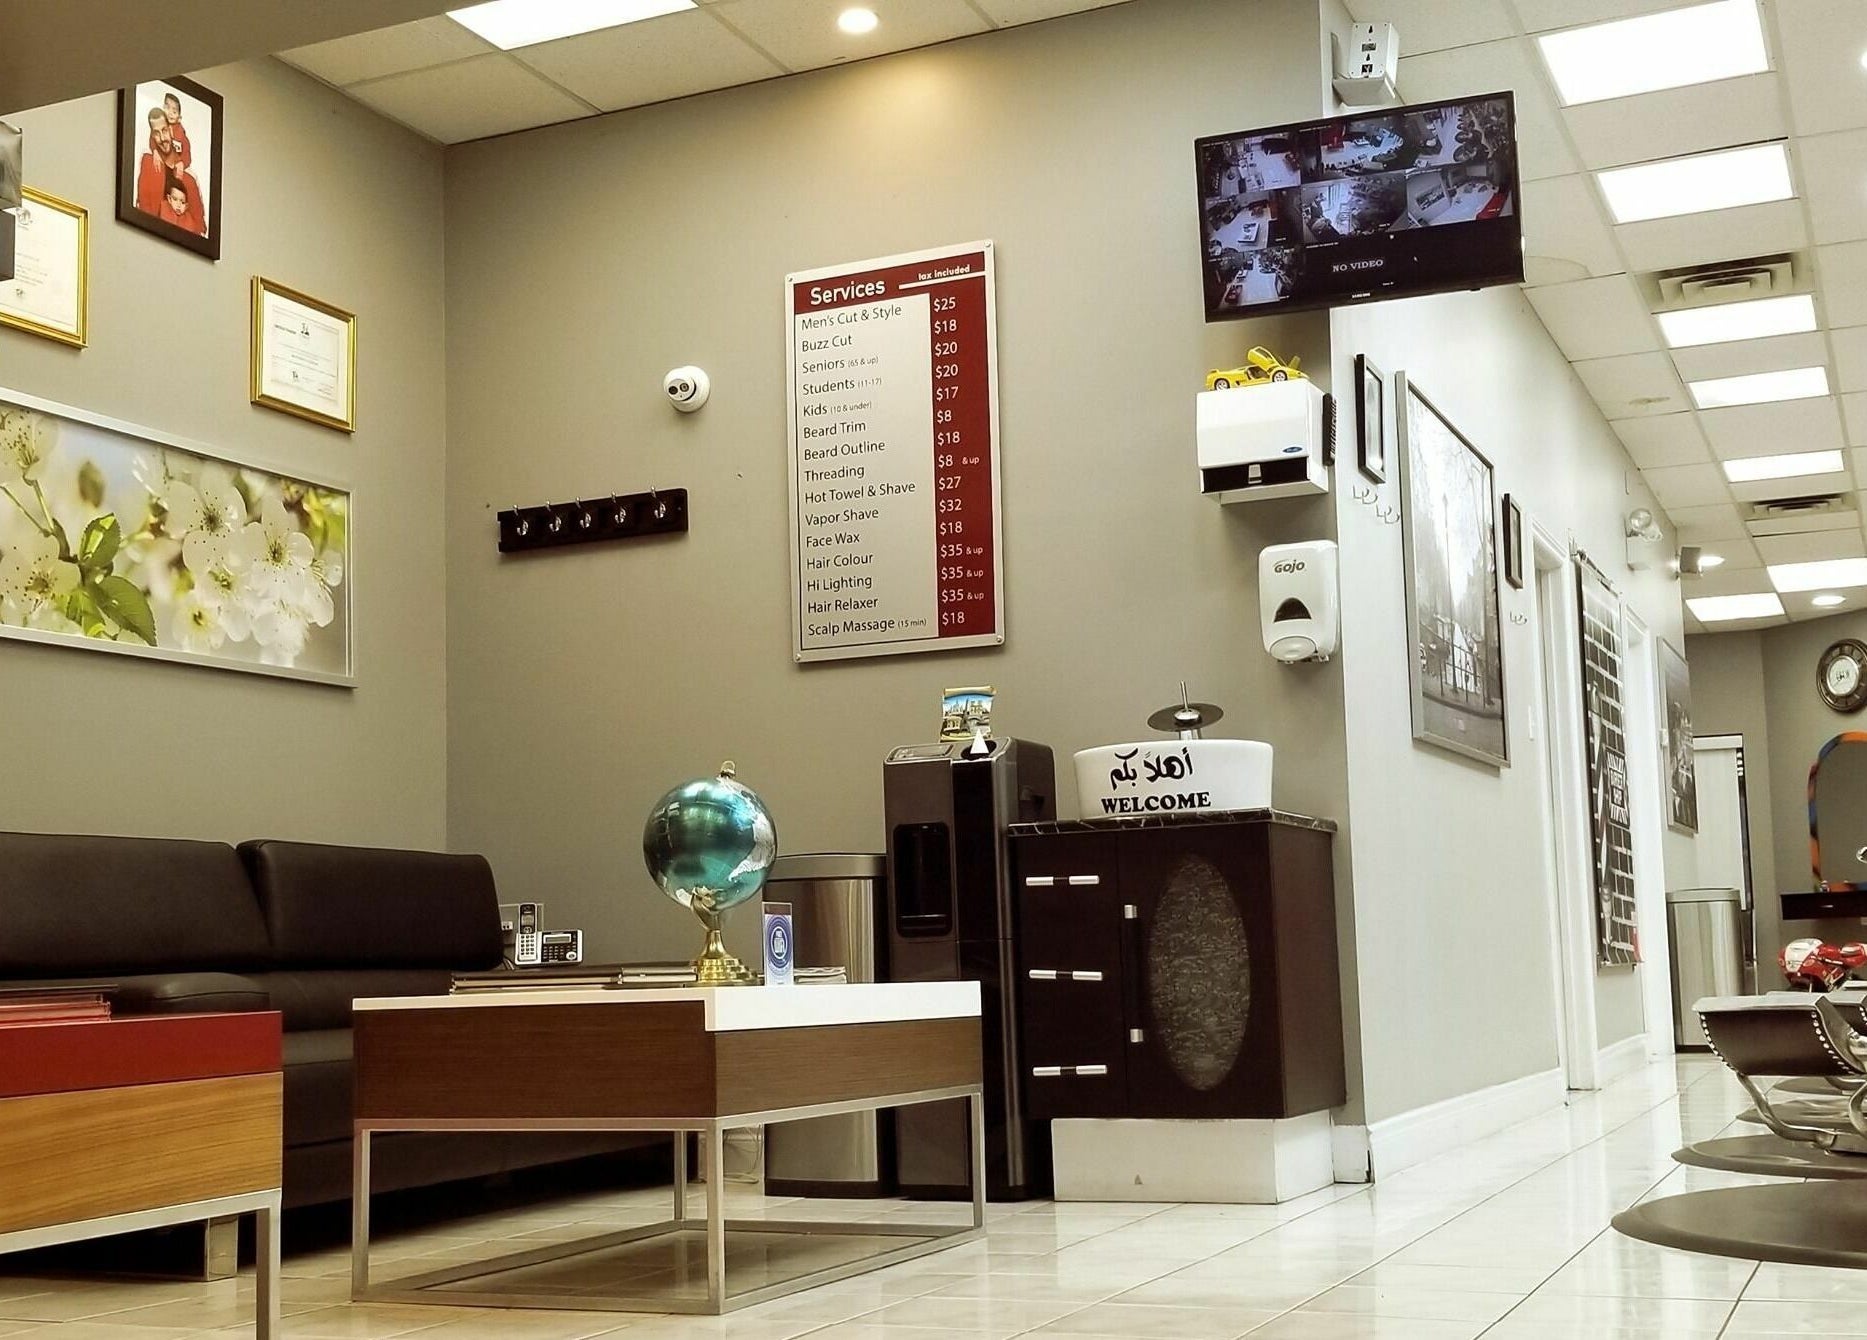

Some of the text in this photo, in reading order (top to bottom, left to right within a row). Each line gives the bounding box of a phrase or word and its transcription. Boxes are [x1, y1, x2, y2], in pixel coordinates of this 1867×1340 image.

[918, 264, 971, 281] tax included
[1333, 259, 1383, 272] NO VIDEO
[810, 280, 886, 305] Services
[933, 296, 956, 312] $25
[837, 310, 859, 324] Cut
[861, 308, 870, 321] &
[872, 304, 902, 321] Style
[934, 319, 957, 334] $18
[802, 335, 852, 352] Buzz Cut
[935, 342, 958, 357] $20
[802, 358, 845, 374] Seniors
[935, 364, 958, 379] $20
[802, 379, 855, 396] Students
[936, 386, 959, 401] $17
[803, 403, 827, 417] Kids
[830, 405, 841, 415] (10
[849, 401, 872, 411] under)
[937, 410, 952, 424] $8
[804, 421, 866, 439] Beard Trim
[937, 432, 960, 446] $18
[804, 440, 885, 461] Beard Outline
[938, 454, 980, 468] $8 & up
[804, 465, 865, 482] Threading
[939, 476, 961, 490] $27
[805, 481, 916, 504] Hot Towel & Shave
[939, 499, 962, 513] $32
[805, 508, 879, 528] Vapor Shave
[940, 521, 963, 536] $18
[806, 532, 860, 548] Face Wax
[940, 544, 963, 559] $35
[973, 547, 983, 555] up
[807, 553, 873, 570] Hair Colour
[941, 567, 963, 581] $35
[974, 569, 984, 578] up
[807, 576, 872, 592] Hi Lighting
[942, 589, 964, 603] $35
[974, 592, 984, 600] up
[808, 597, 878, 614] Hair Relaxer
[808, 617, 927, 636] Scalp Massage (15 min)
[942, 612, 965, 626] $18
[1101, 792, 1211, 814] WELCOME
